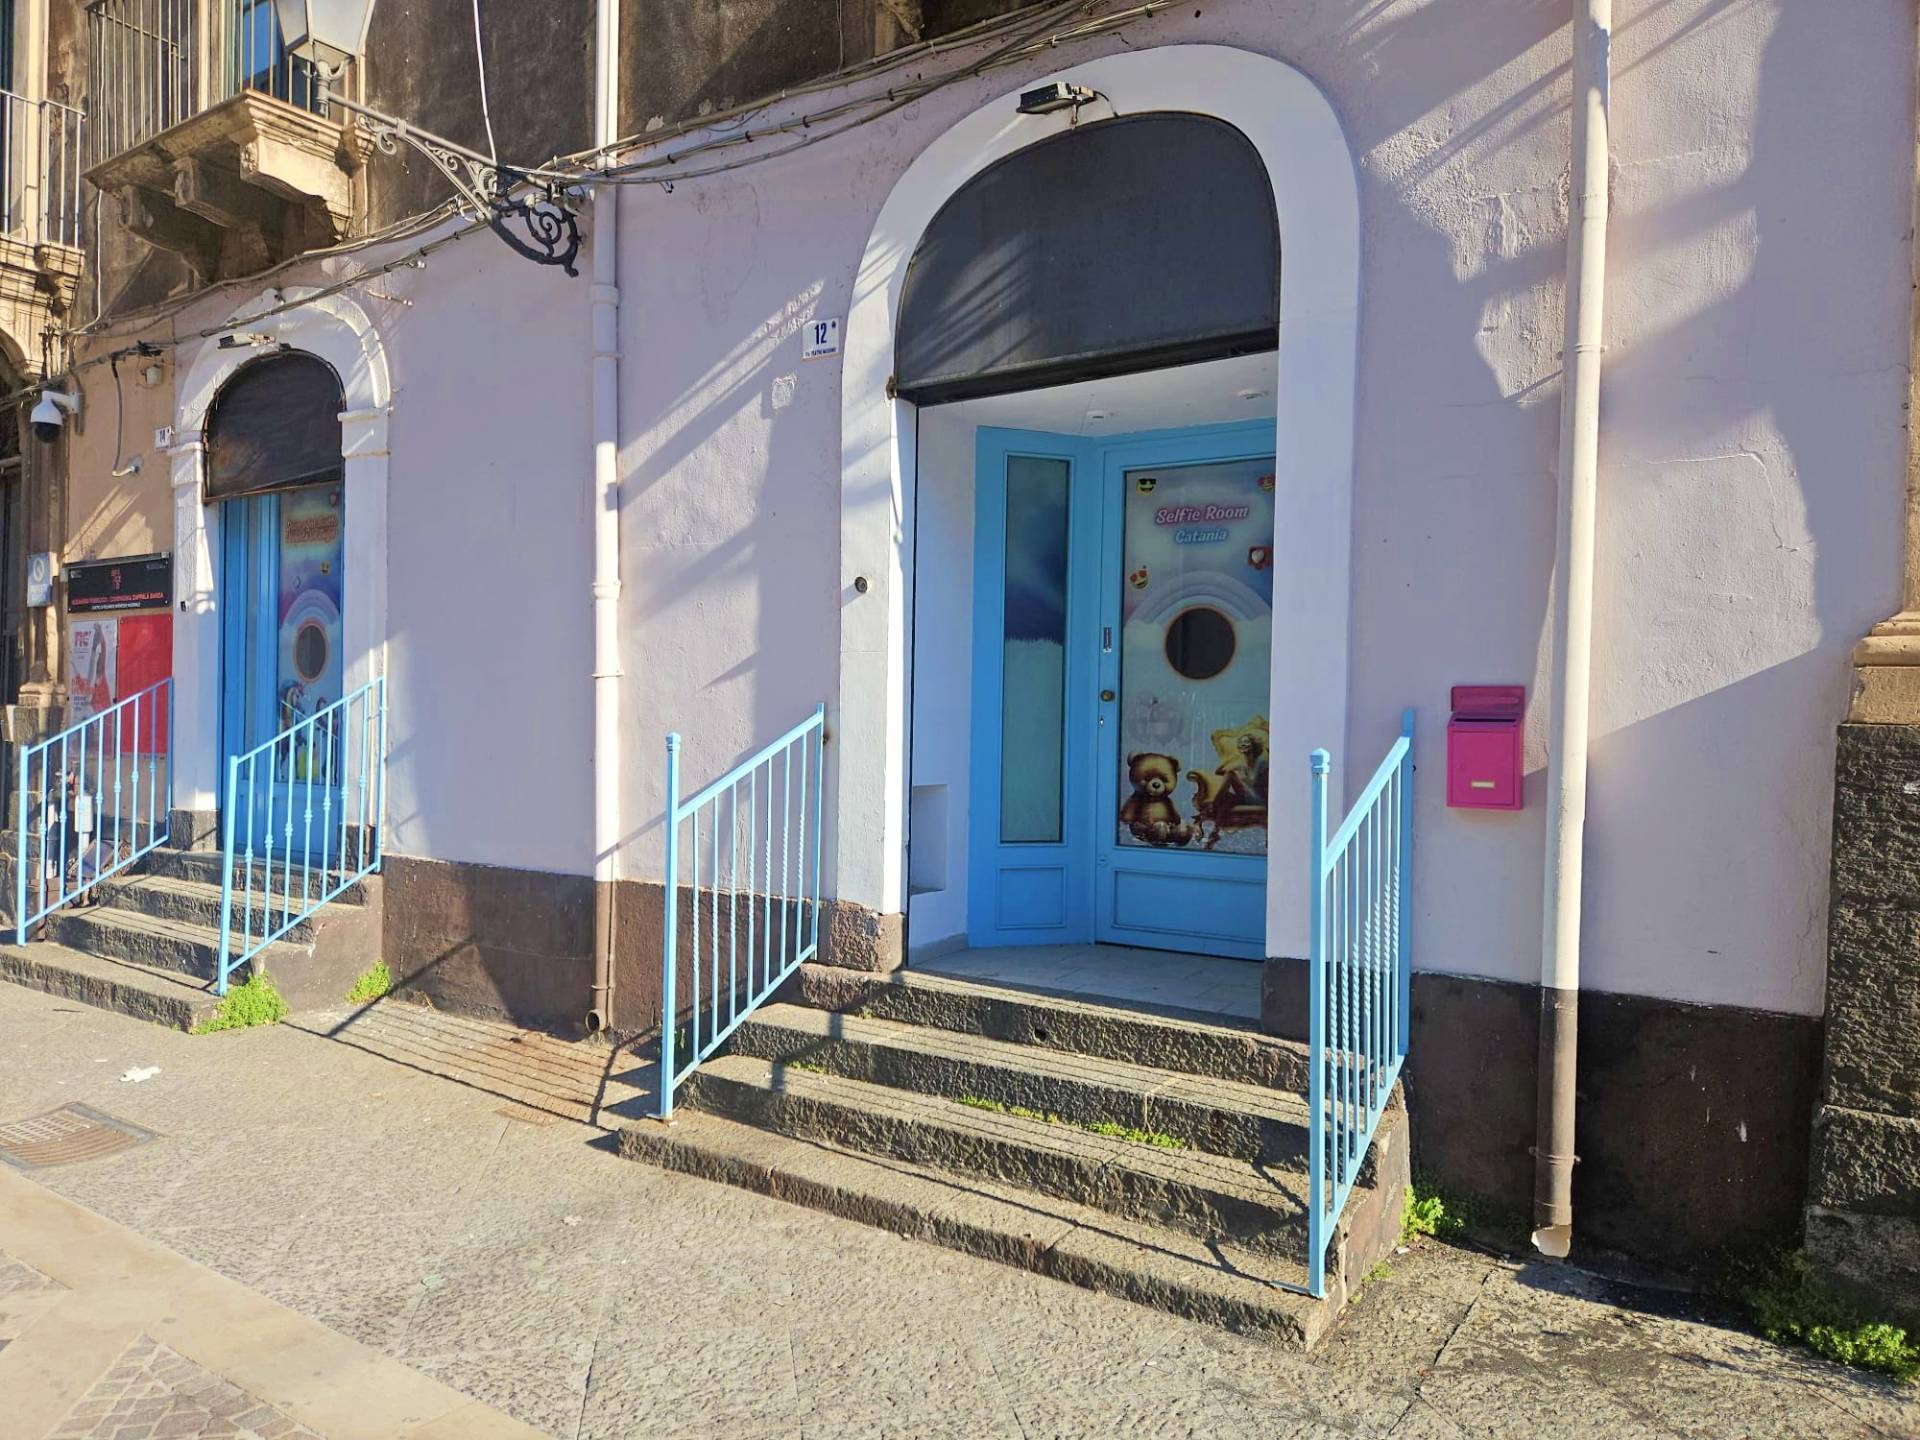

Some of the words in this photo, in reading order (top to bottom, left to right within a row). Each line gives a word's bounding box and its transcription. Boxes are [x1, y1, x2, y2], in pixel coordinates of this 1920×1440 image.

[814, 322, 827, 345] 12
[1155, 507, 1201, 524] Selfie
[1205, 505, 1248, 520] Room
[1175, 528, 1228, 543] Catania
